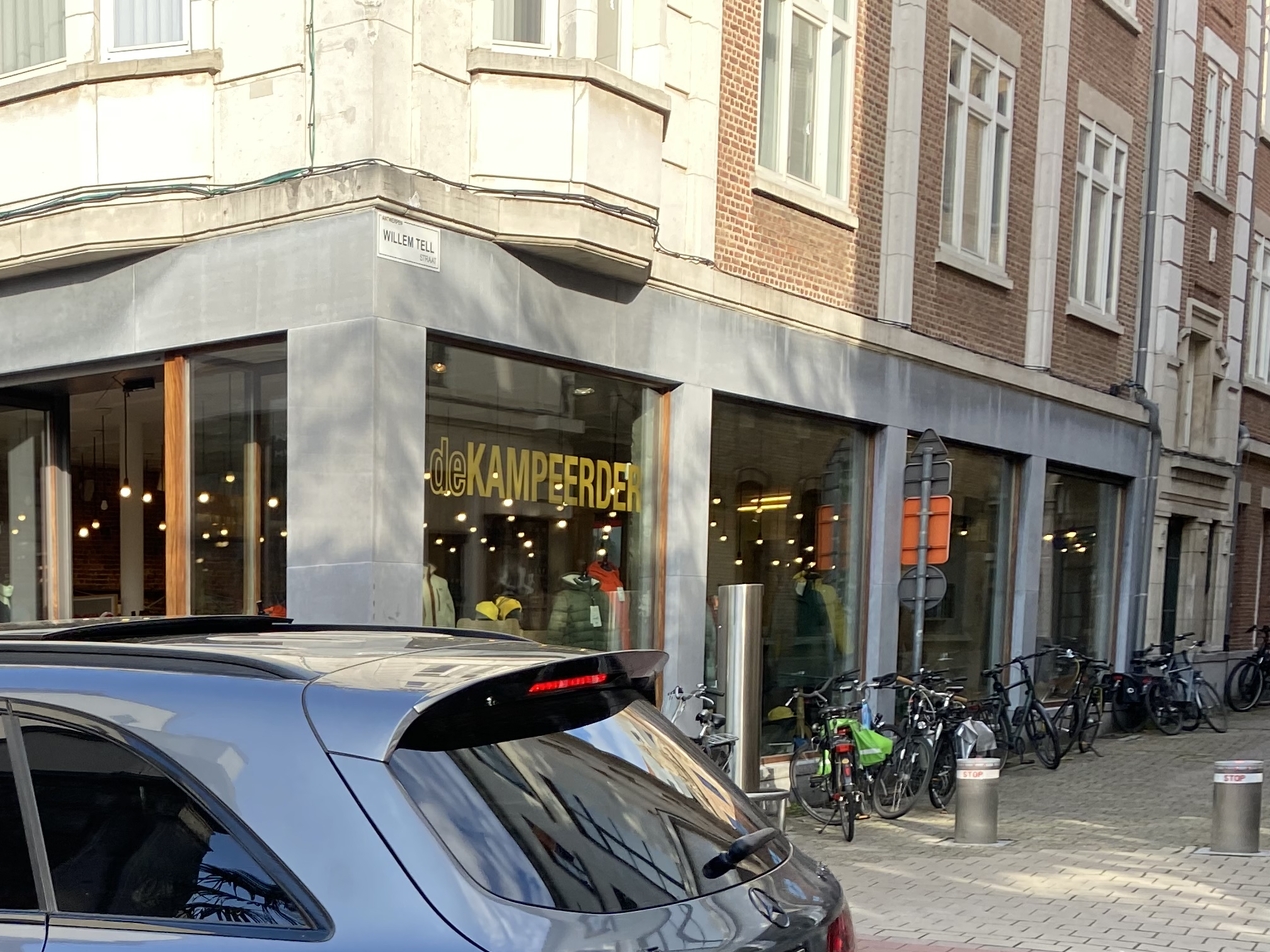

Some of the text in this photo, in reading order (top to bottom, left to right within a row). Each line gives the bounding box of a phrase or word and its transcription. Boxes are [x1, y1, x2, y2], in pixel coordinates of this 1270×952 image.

[383, 229, 435, 254] WILLEM TELL
[420, 254, 437, 264] STRAAT
[430, 437, 643, 512] deKAMPEERDER
